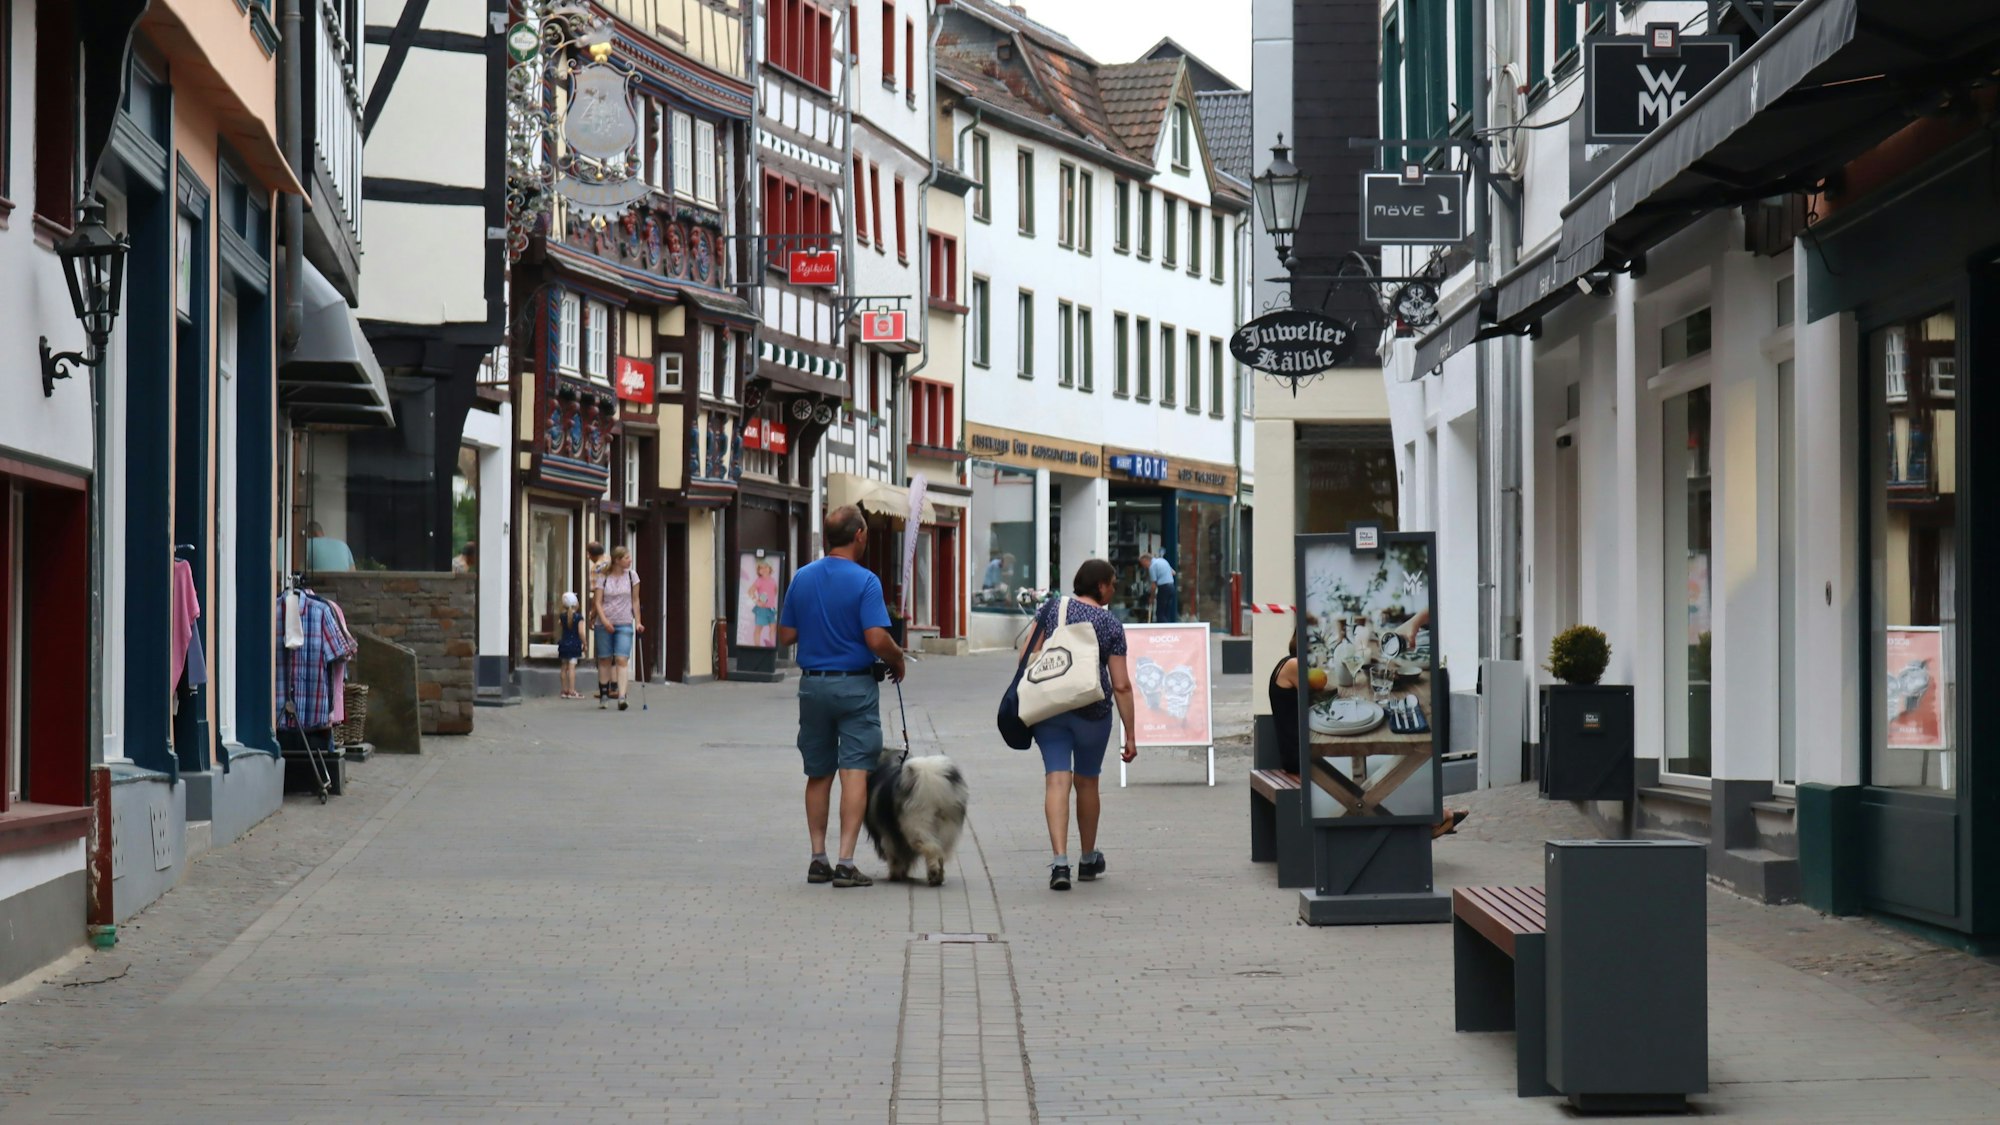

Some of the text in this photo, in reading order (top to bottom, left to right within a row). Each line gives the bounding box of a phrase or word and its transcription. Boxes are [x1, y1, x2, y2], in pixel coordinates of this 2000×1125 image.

[1240, 320, 1346, 352] Juwelier
[1252, 347, 1335, 371] Kälble
[1135, 456, 1168, 480] ROTH
[1149, 635, 1180, 644] BOCCIA
